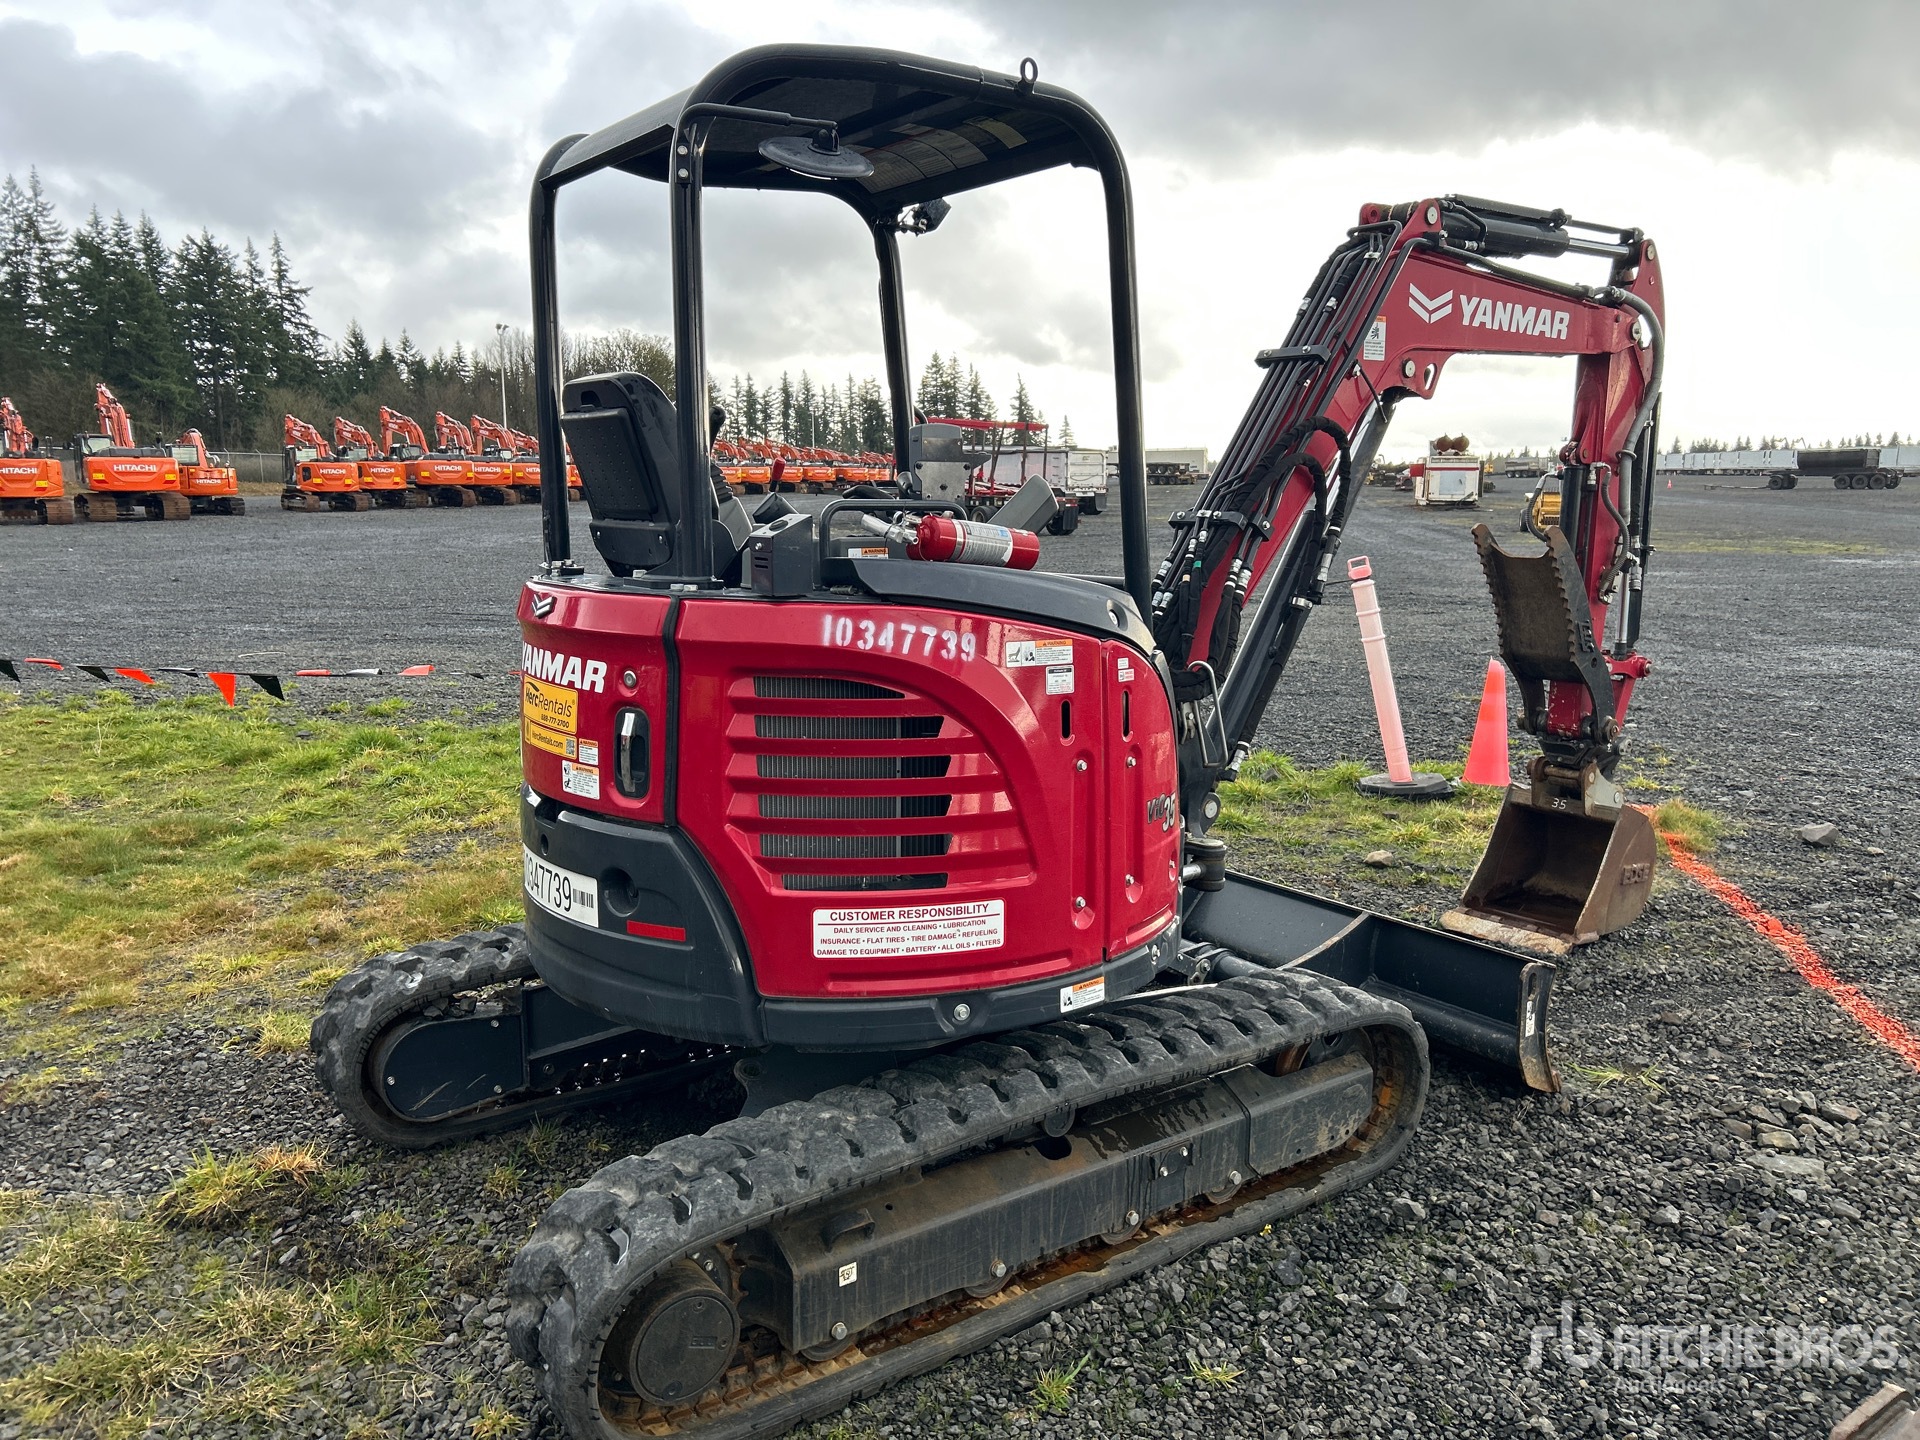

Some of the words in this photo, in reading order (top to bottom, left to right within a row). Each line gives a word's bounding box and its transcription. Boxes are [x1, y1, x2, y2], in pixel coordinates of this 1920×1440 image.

[1459, 295, 1570, 340] YANMAR
[113, 464, 158, 472] HITACHI
[822, 614, 977, 662] 10347739
[522, 640, 607, 694] YANMAR
[525, 686, 573, 718] HercRentals
[1552, 797, 1568, 810] 35
[830, 911, 896, 921] CUSTOMER
[899, 903, 989, 919] RESPONSIBILITY
[902, 923, 938, 932] CLEANING
[942, 919, 987, 929] LUBRICATION
[927, 932, 957, 941] DAMAGE
[962, 928, 998, 938] REFUELING
[859, 947, 900, 955] EQUIPMENT
[905, 945, 937, 953] BATTERY
[955, 941, 971, 950] OILS
[975, 938, 1001, 948] FILTERS
